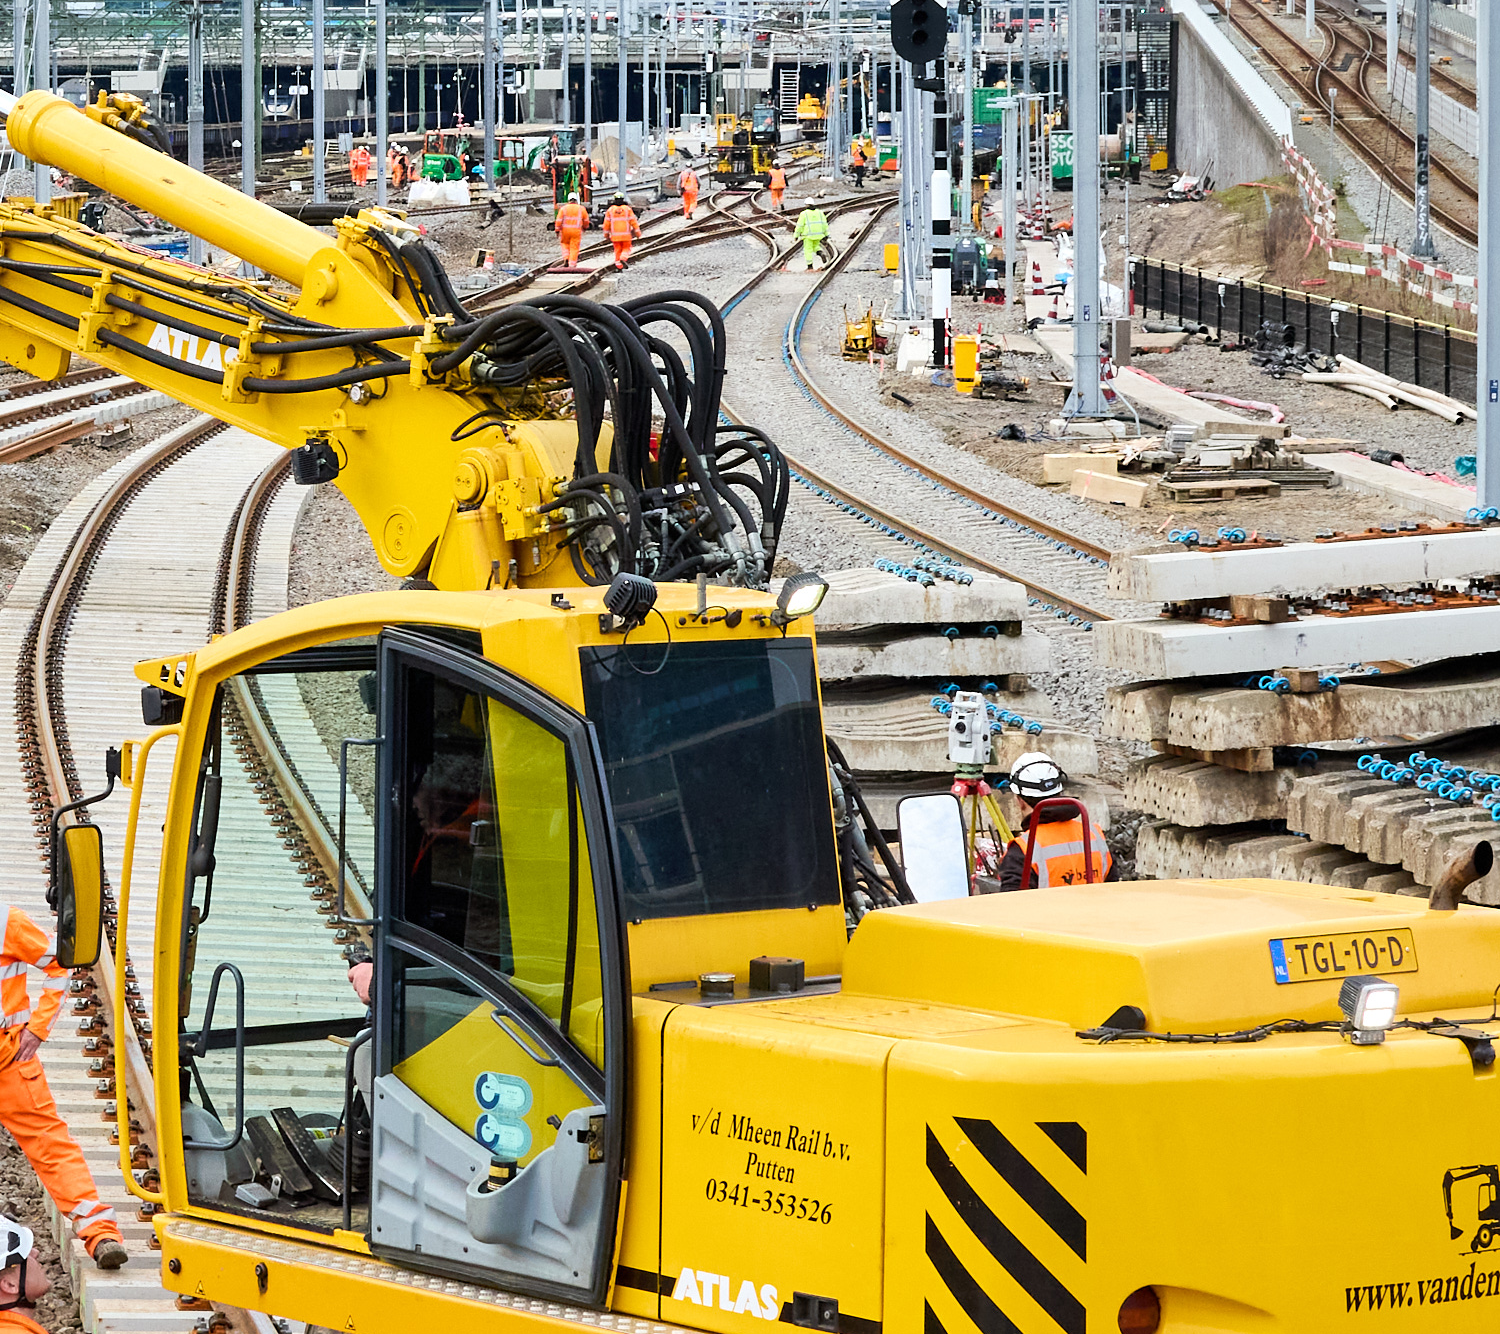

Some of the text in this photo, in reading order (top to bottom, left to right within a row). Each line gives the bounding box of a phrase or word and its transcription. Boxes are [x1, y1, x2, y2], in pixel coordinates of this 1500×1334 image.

[1275, 965, 1287, 976] NL
[1294, 936, 1403, 975] TGL-10-D
[691, 1107, 850, 1161] v/d Mheen Rail b.v.
[744, 1151, 795, 1183] Putten
[705, 1178, 833, 1224] 0341-353526
[673, 1267, 779, 1321] ATLAS
